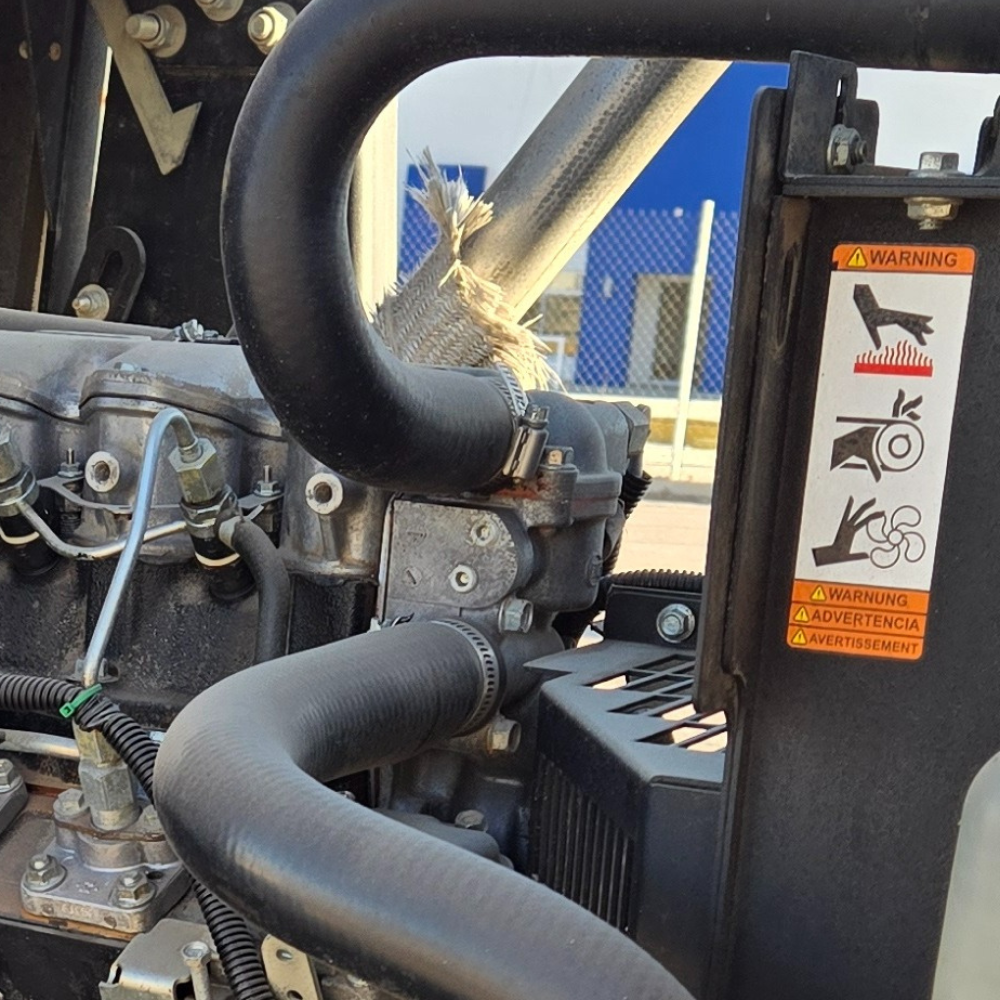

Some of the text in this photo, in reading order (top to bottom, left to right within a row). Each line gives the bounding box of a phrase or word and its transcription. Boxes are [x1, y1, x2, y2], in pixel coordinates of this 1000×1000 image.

[869, 250, 958, 268] WARNING
[828, 587, 908, 608] WARNUNG
[811, 610, 920, 632] ADVERTENCIA
[808, 632, 920, 656] AVERTISSEMENT
